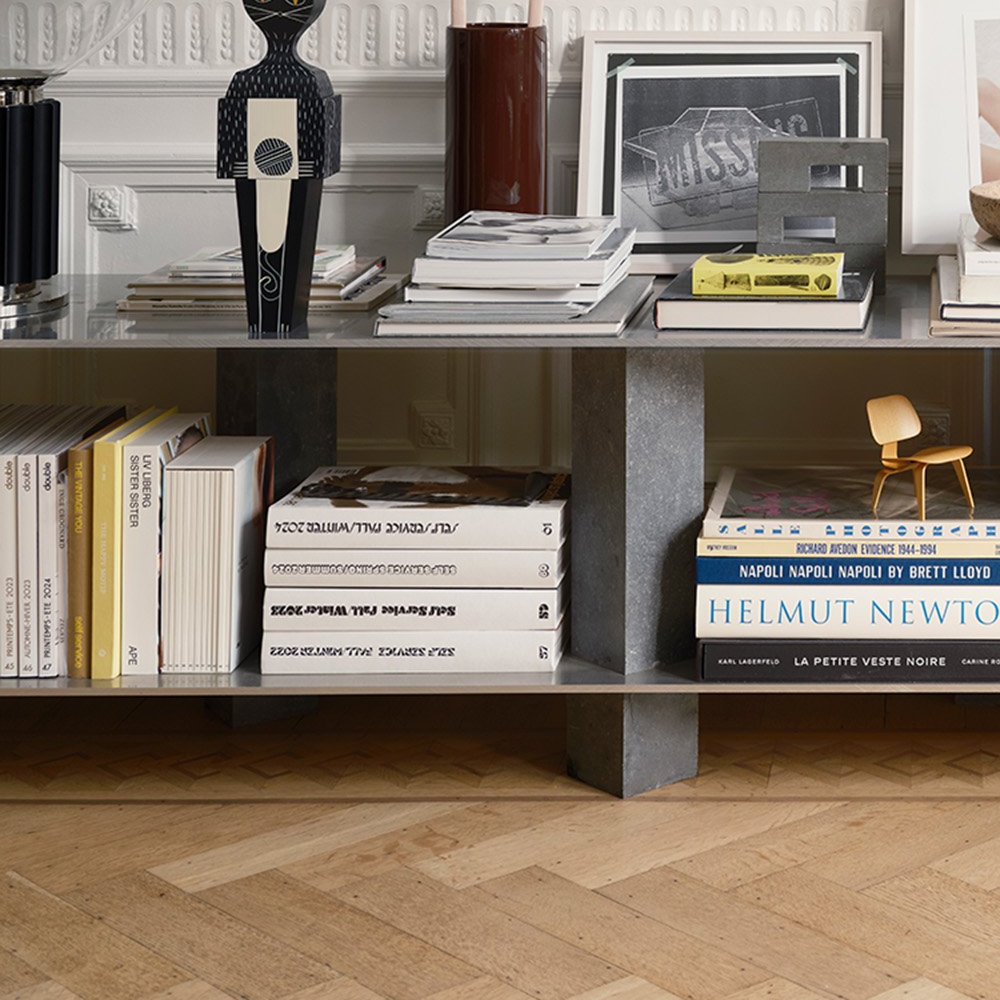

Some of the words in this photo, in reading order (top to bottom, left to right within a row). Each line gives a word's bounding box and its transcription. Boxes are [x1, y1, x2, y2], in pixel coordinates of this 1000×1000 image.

[4, 460, 13, 490] double
[75, 461, 84, 478] THE
[129, 454, 140, 490] SISTER
[22, 462, 31, 492] double
[42, 461, 52, 491] double
[74, 479, 83, 514] VINTAGE
[129, 492, 140, 529] SISTER
[74, 515, 83, 534] YOU
[275, 522, 306, 534] 2024
[386, 522, 432, 534] SERVICE
[430, 522, 459, 534] SELF
[718, 524, 801, 536] SALLE
[796, 543, 827, 555] RICHARD
[829, 543, 858, 555] AVEDON
[860, 543, 895, 556] EVIDENCE
[898, 543, 937, 556] 1944-1994
[387, 564, 431, 576] SERVICE
[739, 564, 784, 579] NAPOLI
[788, 564, 833, 579] NAPOLI
[838, 564, 883, 579] NAPOLI
[888, 565, 904, 579] BY
[909, 565, 948, 580] BRETT
[953, 565, 991, 580] LLOYD
[270, 605, 304, 617] 2023
[303, 605, 348, 617] Winter
[350, 605, 378, 617] Fall
[381, 605, 428, 617] Service
[429, 605, 456, 617] Self
[708, 599, 855, 625] HELMUT
[128, 644, 138, 666] APE
[270, 646, 300, 657] 2022
[300, 646, 344, 657] WINTER
[344, 646, 374, 657] FALL
[378, 646, 427, 657] SERVICE
[428, 646, 456, 657] SELF
[717, 657, 738, 666] KARL
[738, 657, 781, 666] LAGERFELD
[793, 656, 810, 667] LA
[813, 656, 858, 667] PETITE
[861, 656, 902, 667] VESTE
[906, 656, 947, 667] NOIRE
[960, 657, 989, 666] CARINE
